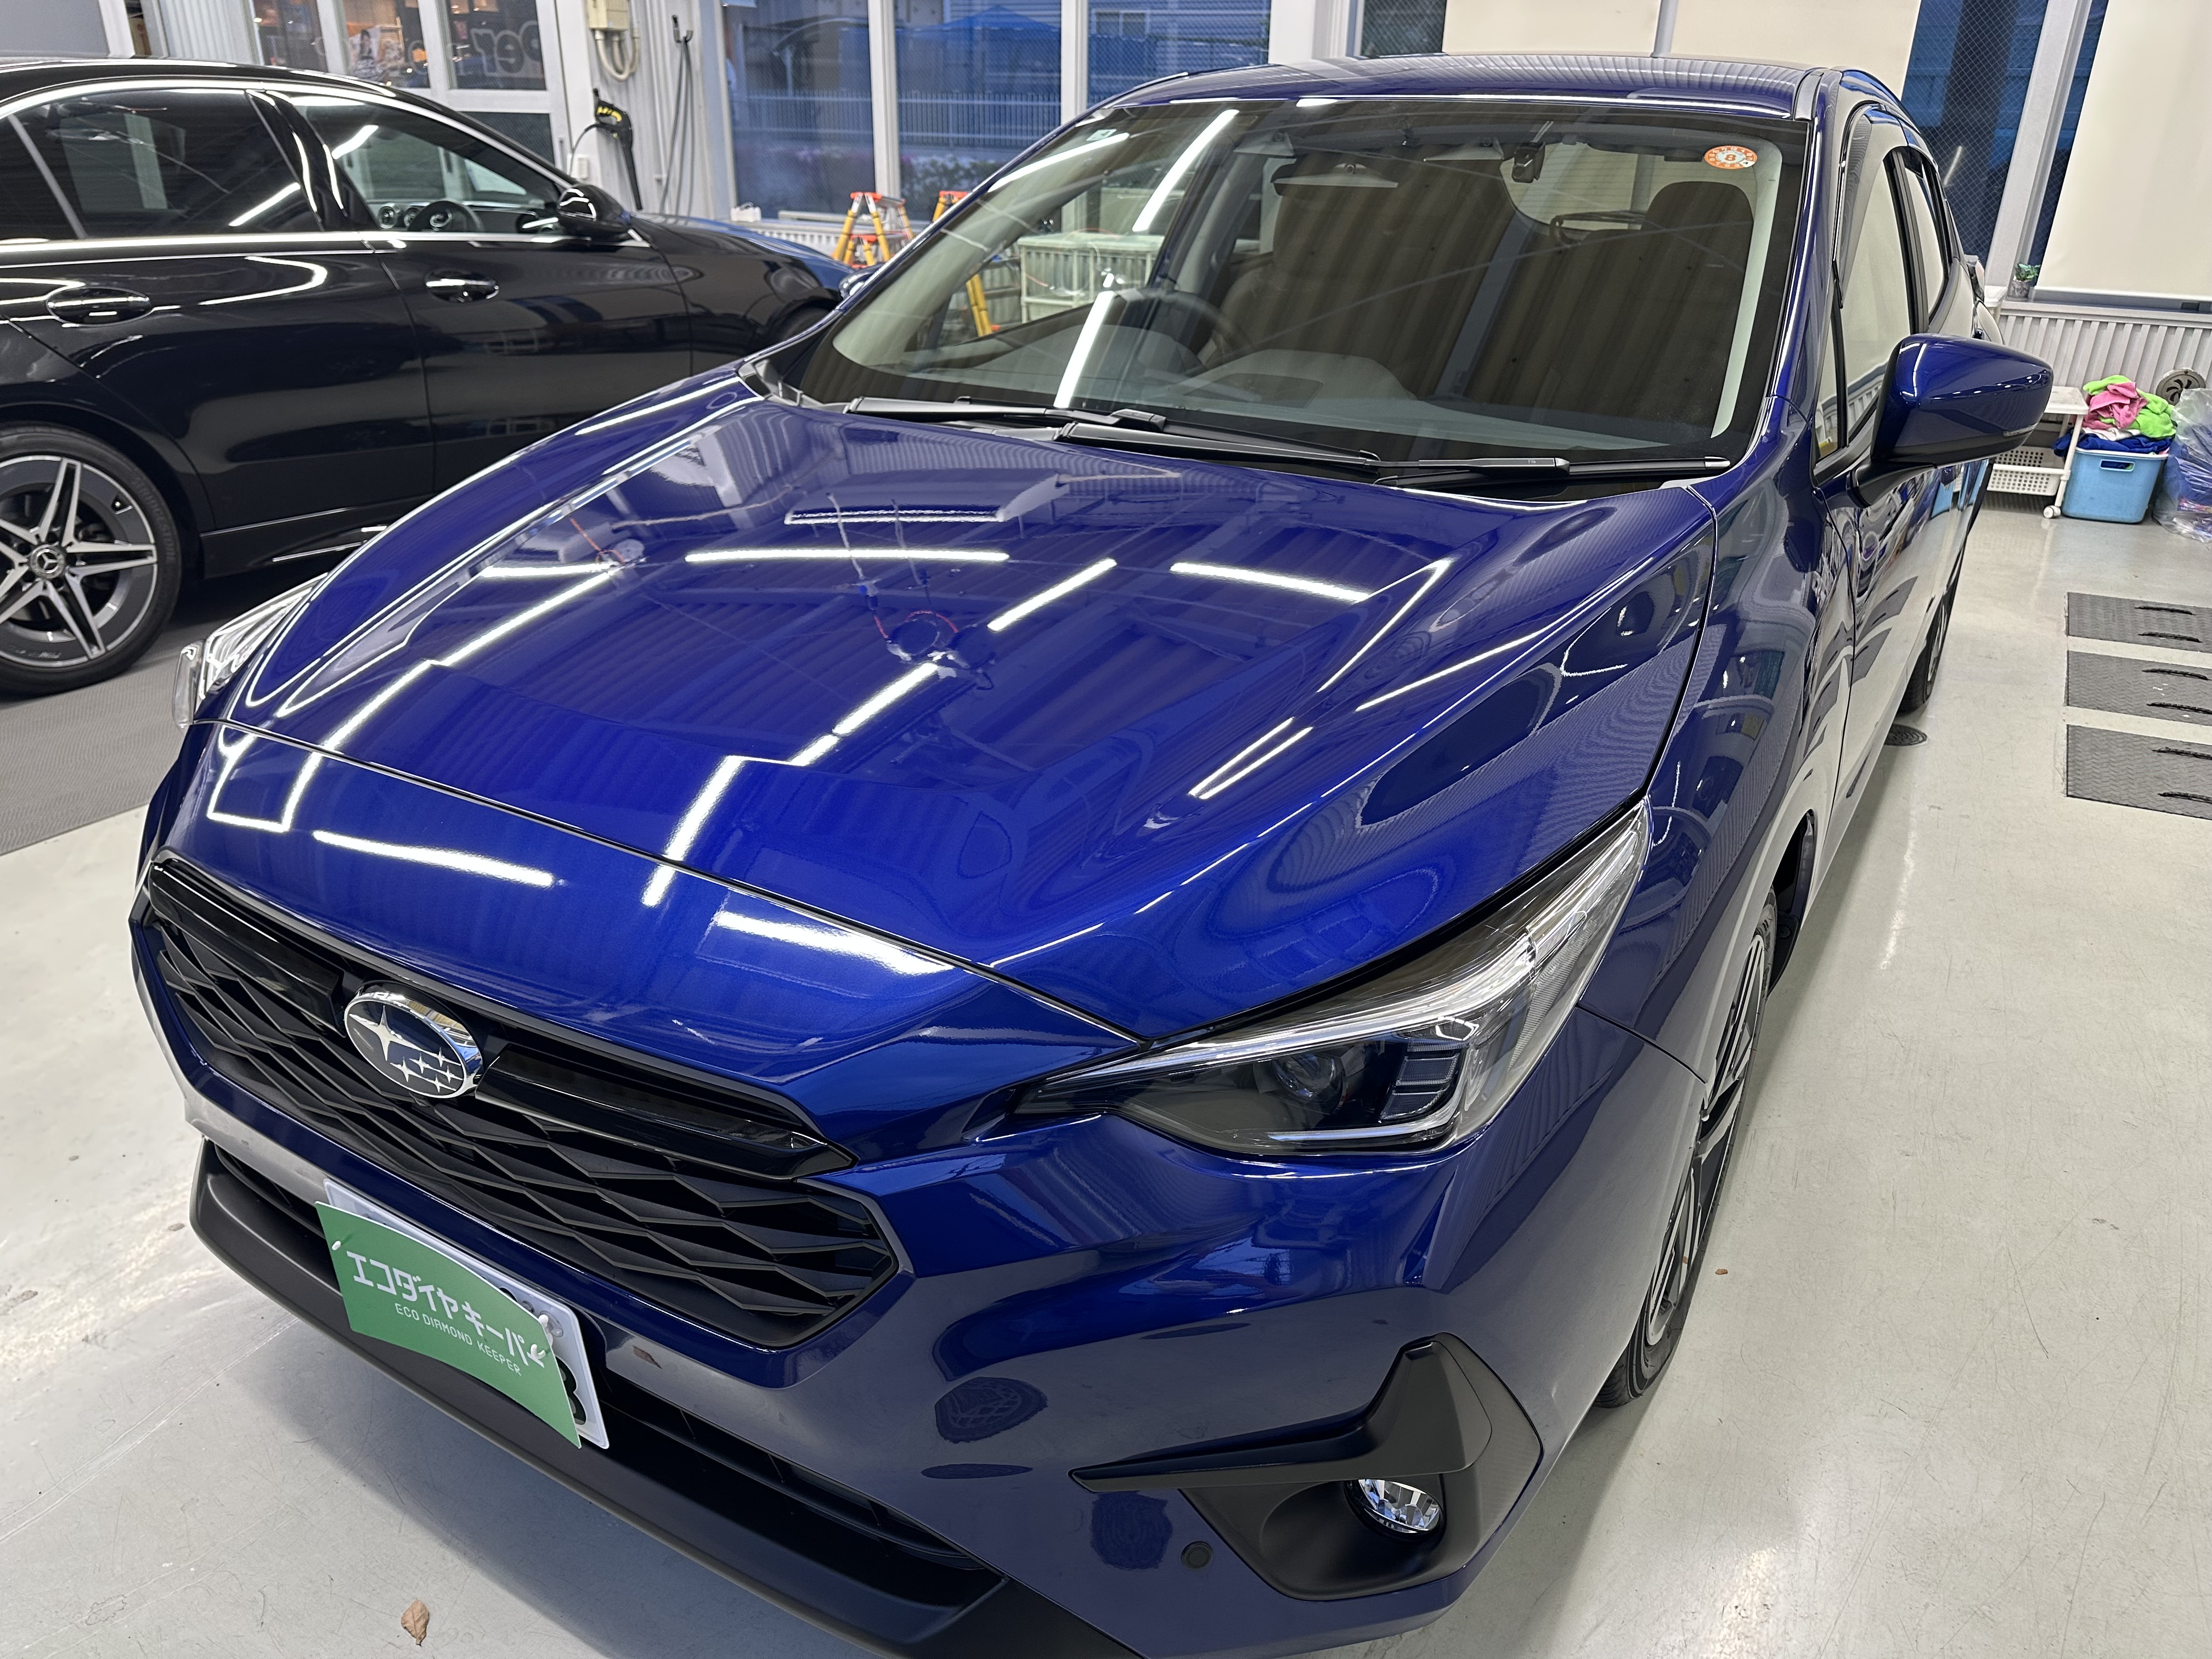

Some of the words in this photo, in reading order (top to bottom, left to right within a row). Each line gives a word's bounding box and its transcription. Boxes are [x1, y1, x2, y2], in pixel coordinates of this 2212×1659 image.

[346, 1251, 544, 1368] エコダイヤキーパー
[394, 1303, 420, 1321] ECO
[422, 1313, 472, 1345] DIAMOND
[477, 1340, 521, 1376] KEEPER
